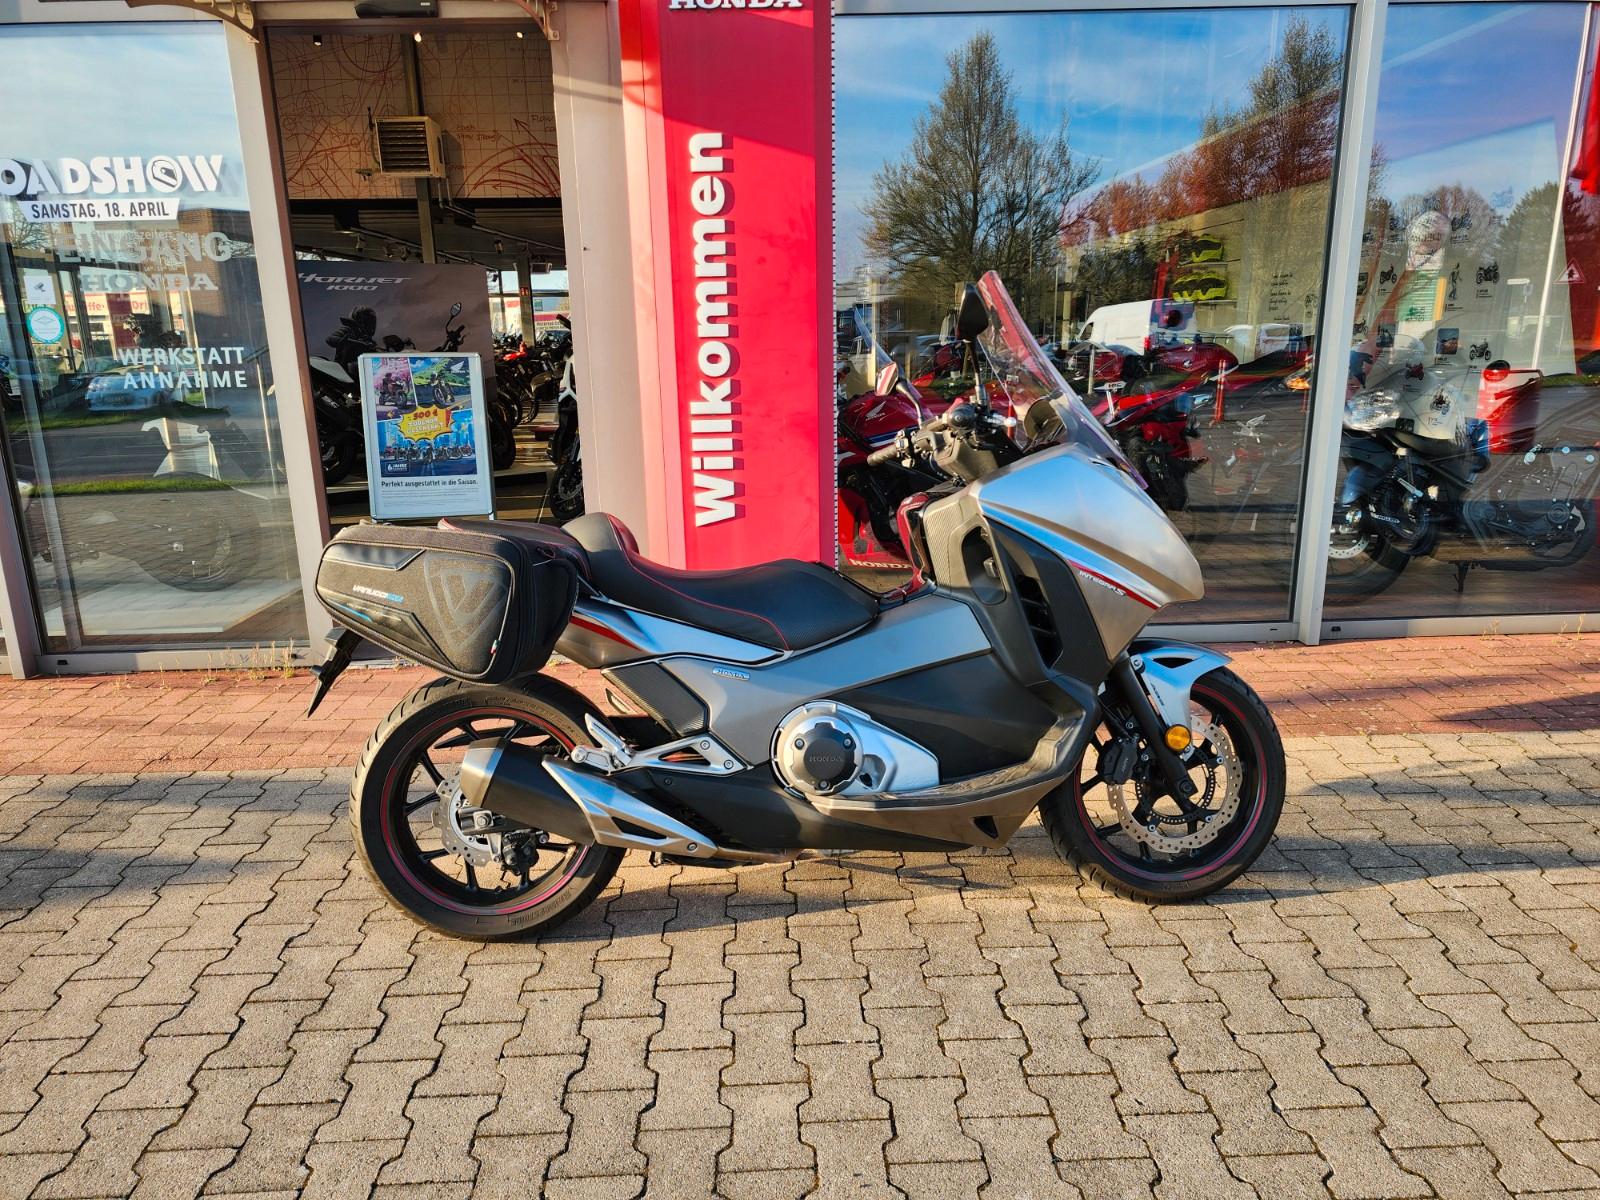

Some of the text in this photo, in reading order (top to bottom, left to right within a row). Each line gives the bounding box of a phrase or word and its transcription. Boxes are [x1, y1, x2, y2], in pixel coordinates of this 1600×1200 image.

[31, 201, 170, 219] SAMSTAG, 18. APRIL
[57, 231, 233, 262] EINGANG
[80, 272, 219, 291] HONDA
[688, 132, 737, 527] Willkommen
[117, 346, 245, 366] WERKSTATT
[123, 370, 248, 389] ANNAHME
[405, 480, 440, 488] ausgestattet
